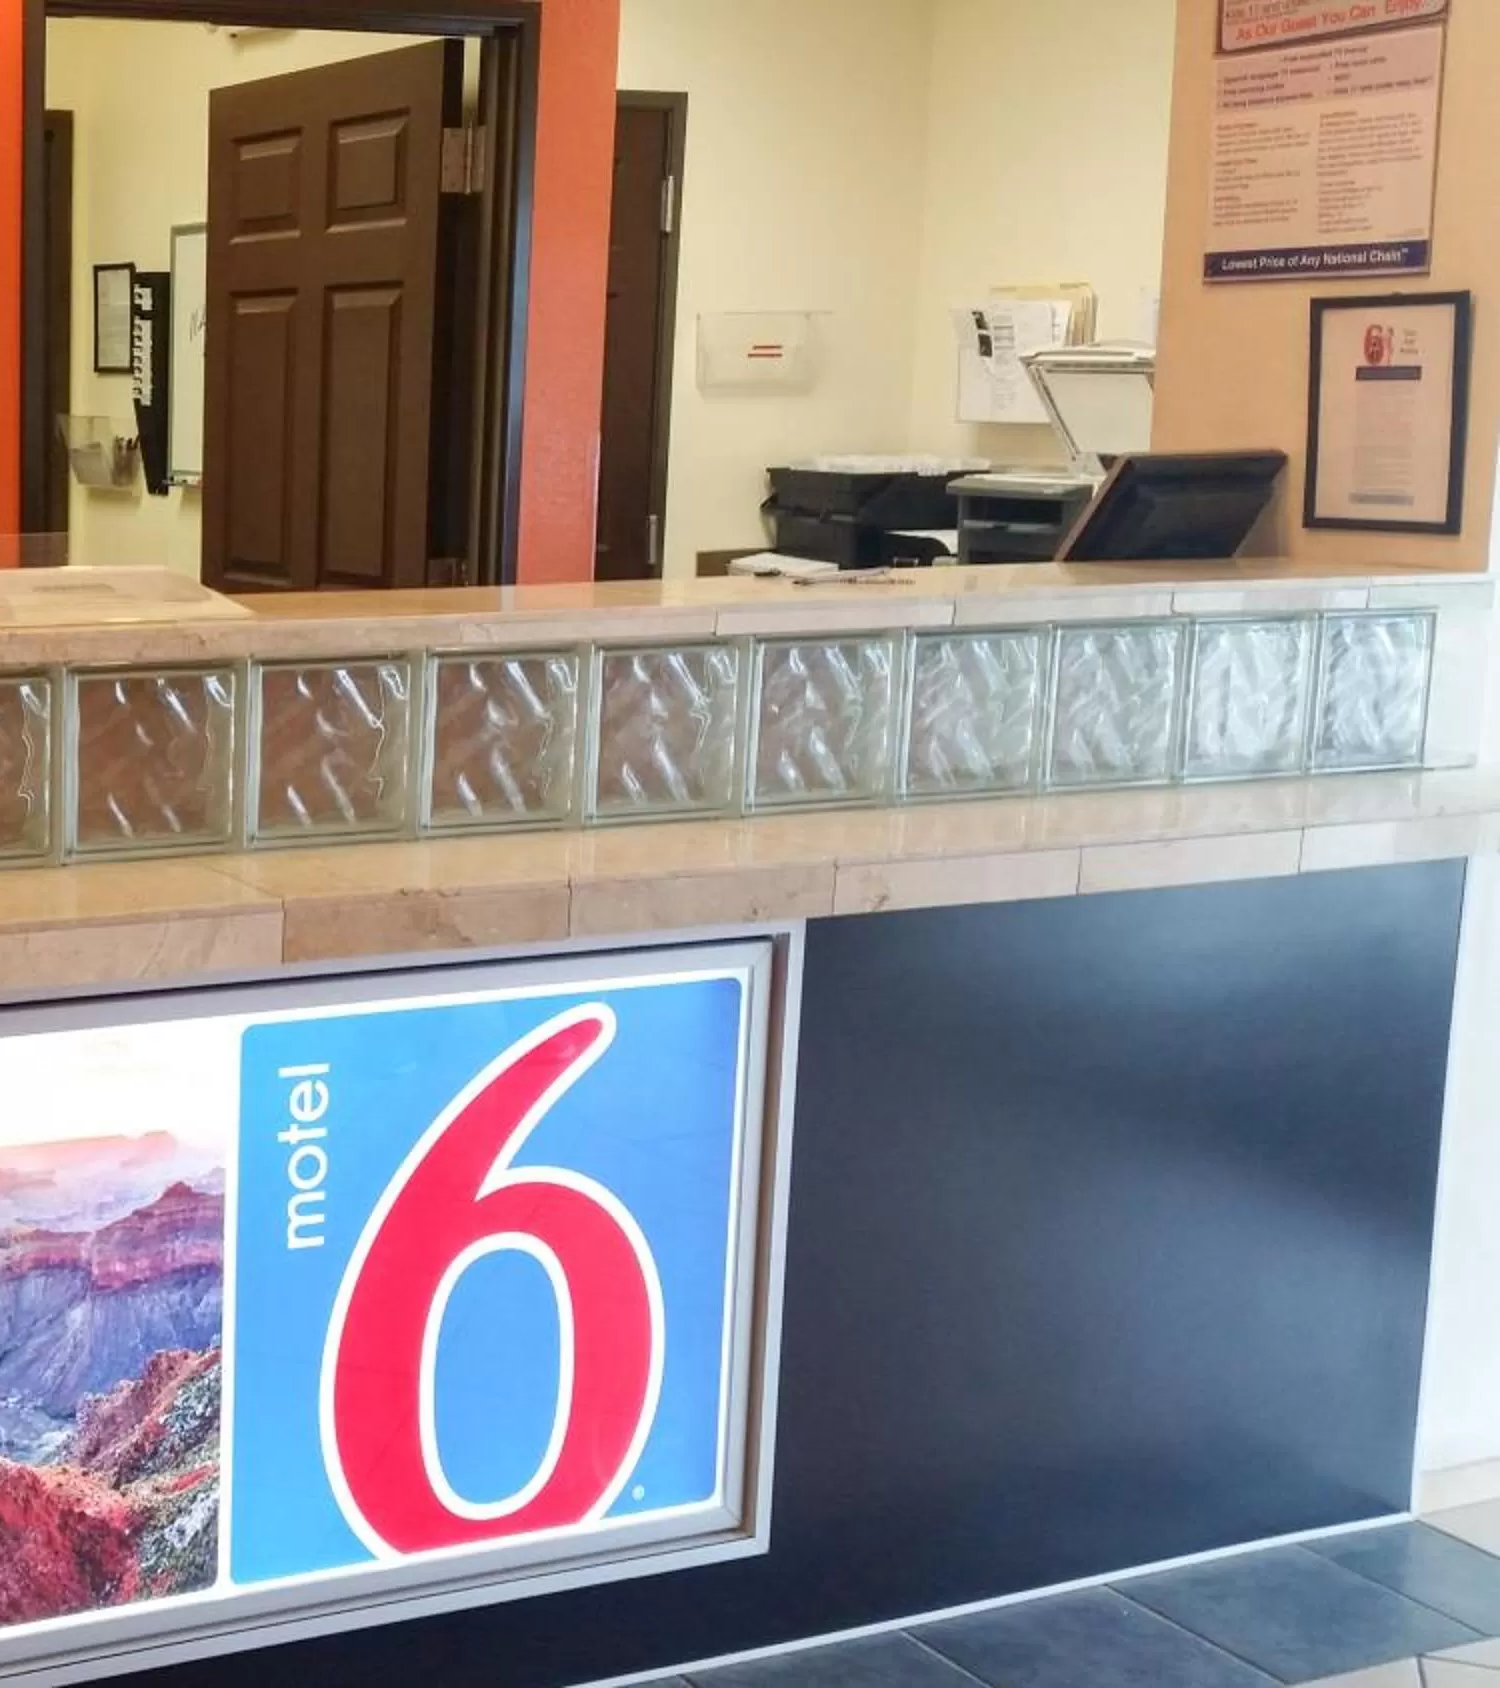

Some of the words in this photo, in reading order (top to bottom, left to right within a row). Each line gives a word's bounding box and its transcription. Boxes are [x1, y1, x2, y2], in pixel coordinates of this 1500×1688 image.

[1255, 22, 1277, 37] Our
[1322, 10, 1346, 25] You
[1349, 5, 1376, 18] Can
[1221, 257, 1257, 271] Lowest
[1259, 255, 1285, 268] Price
[1287, 254, 1299, 267] of
[1299, 253, 1321, 269] Any
[1323, 250, 1367, 266] National
[279, 1062, 329, 1250] motel
[319, 1001, 666, 1565] 6
